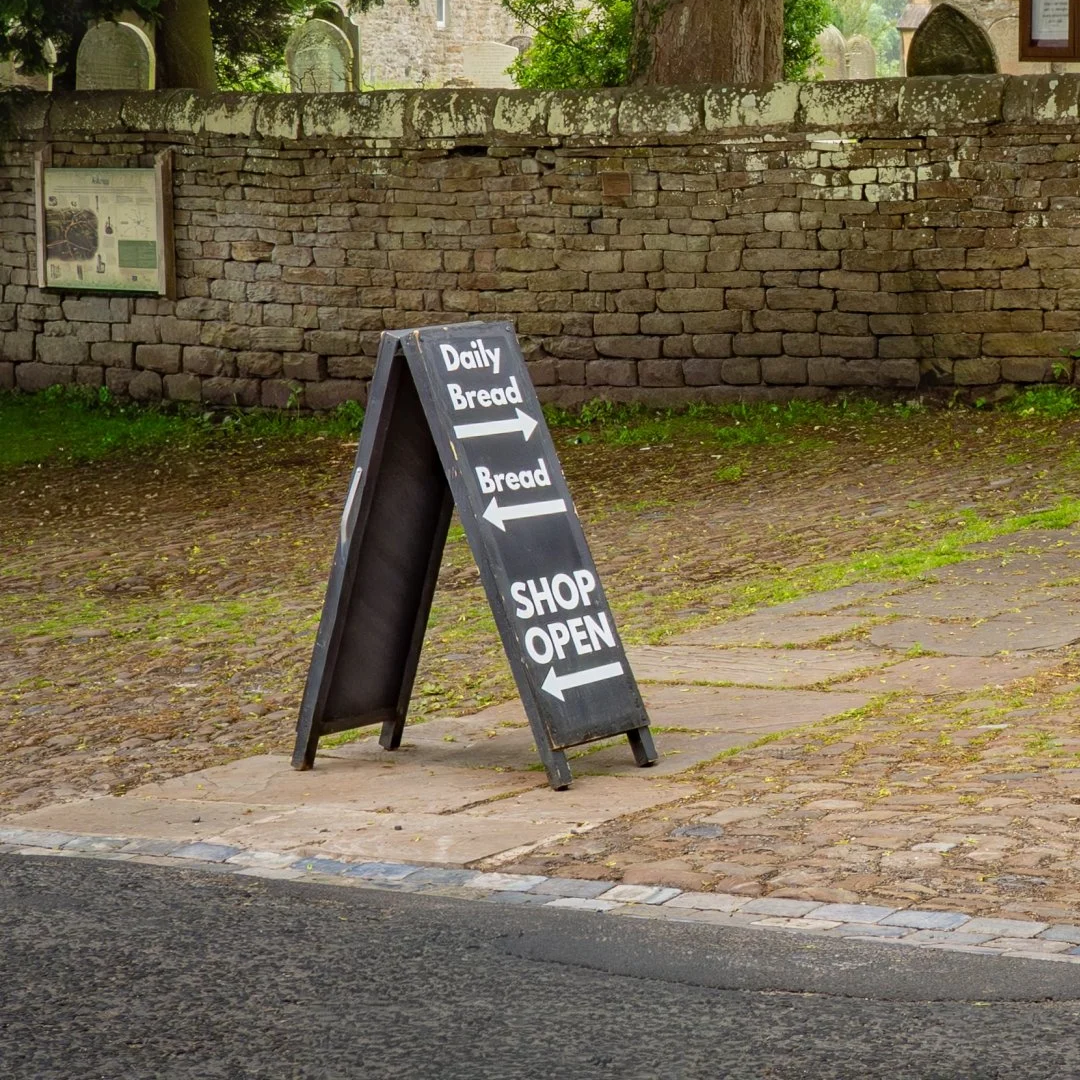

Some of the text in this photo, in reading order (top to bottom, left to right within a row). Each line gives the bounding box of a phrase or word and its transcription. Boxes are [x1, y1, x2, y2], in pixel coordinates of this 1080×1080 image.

[439, 338, 501, 374] Daily
[446, 375, 523, 412] Bread
[475, 458, 552, 495] Bread
[510, 568, 597, 619] SHOP
[524, 610, 616, 665] OPEN
